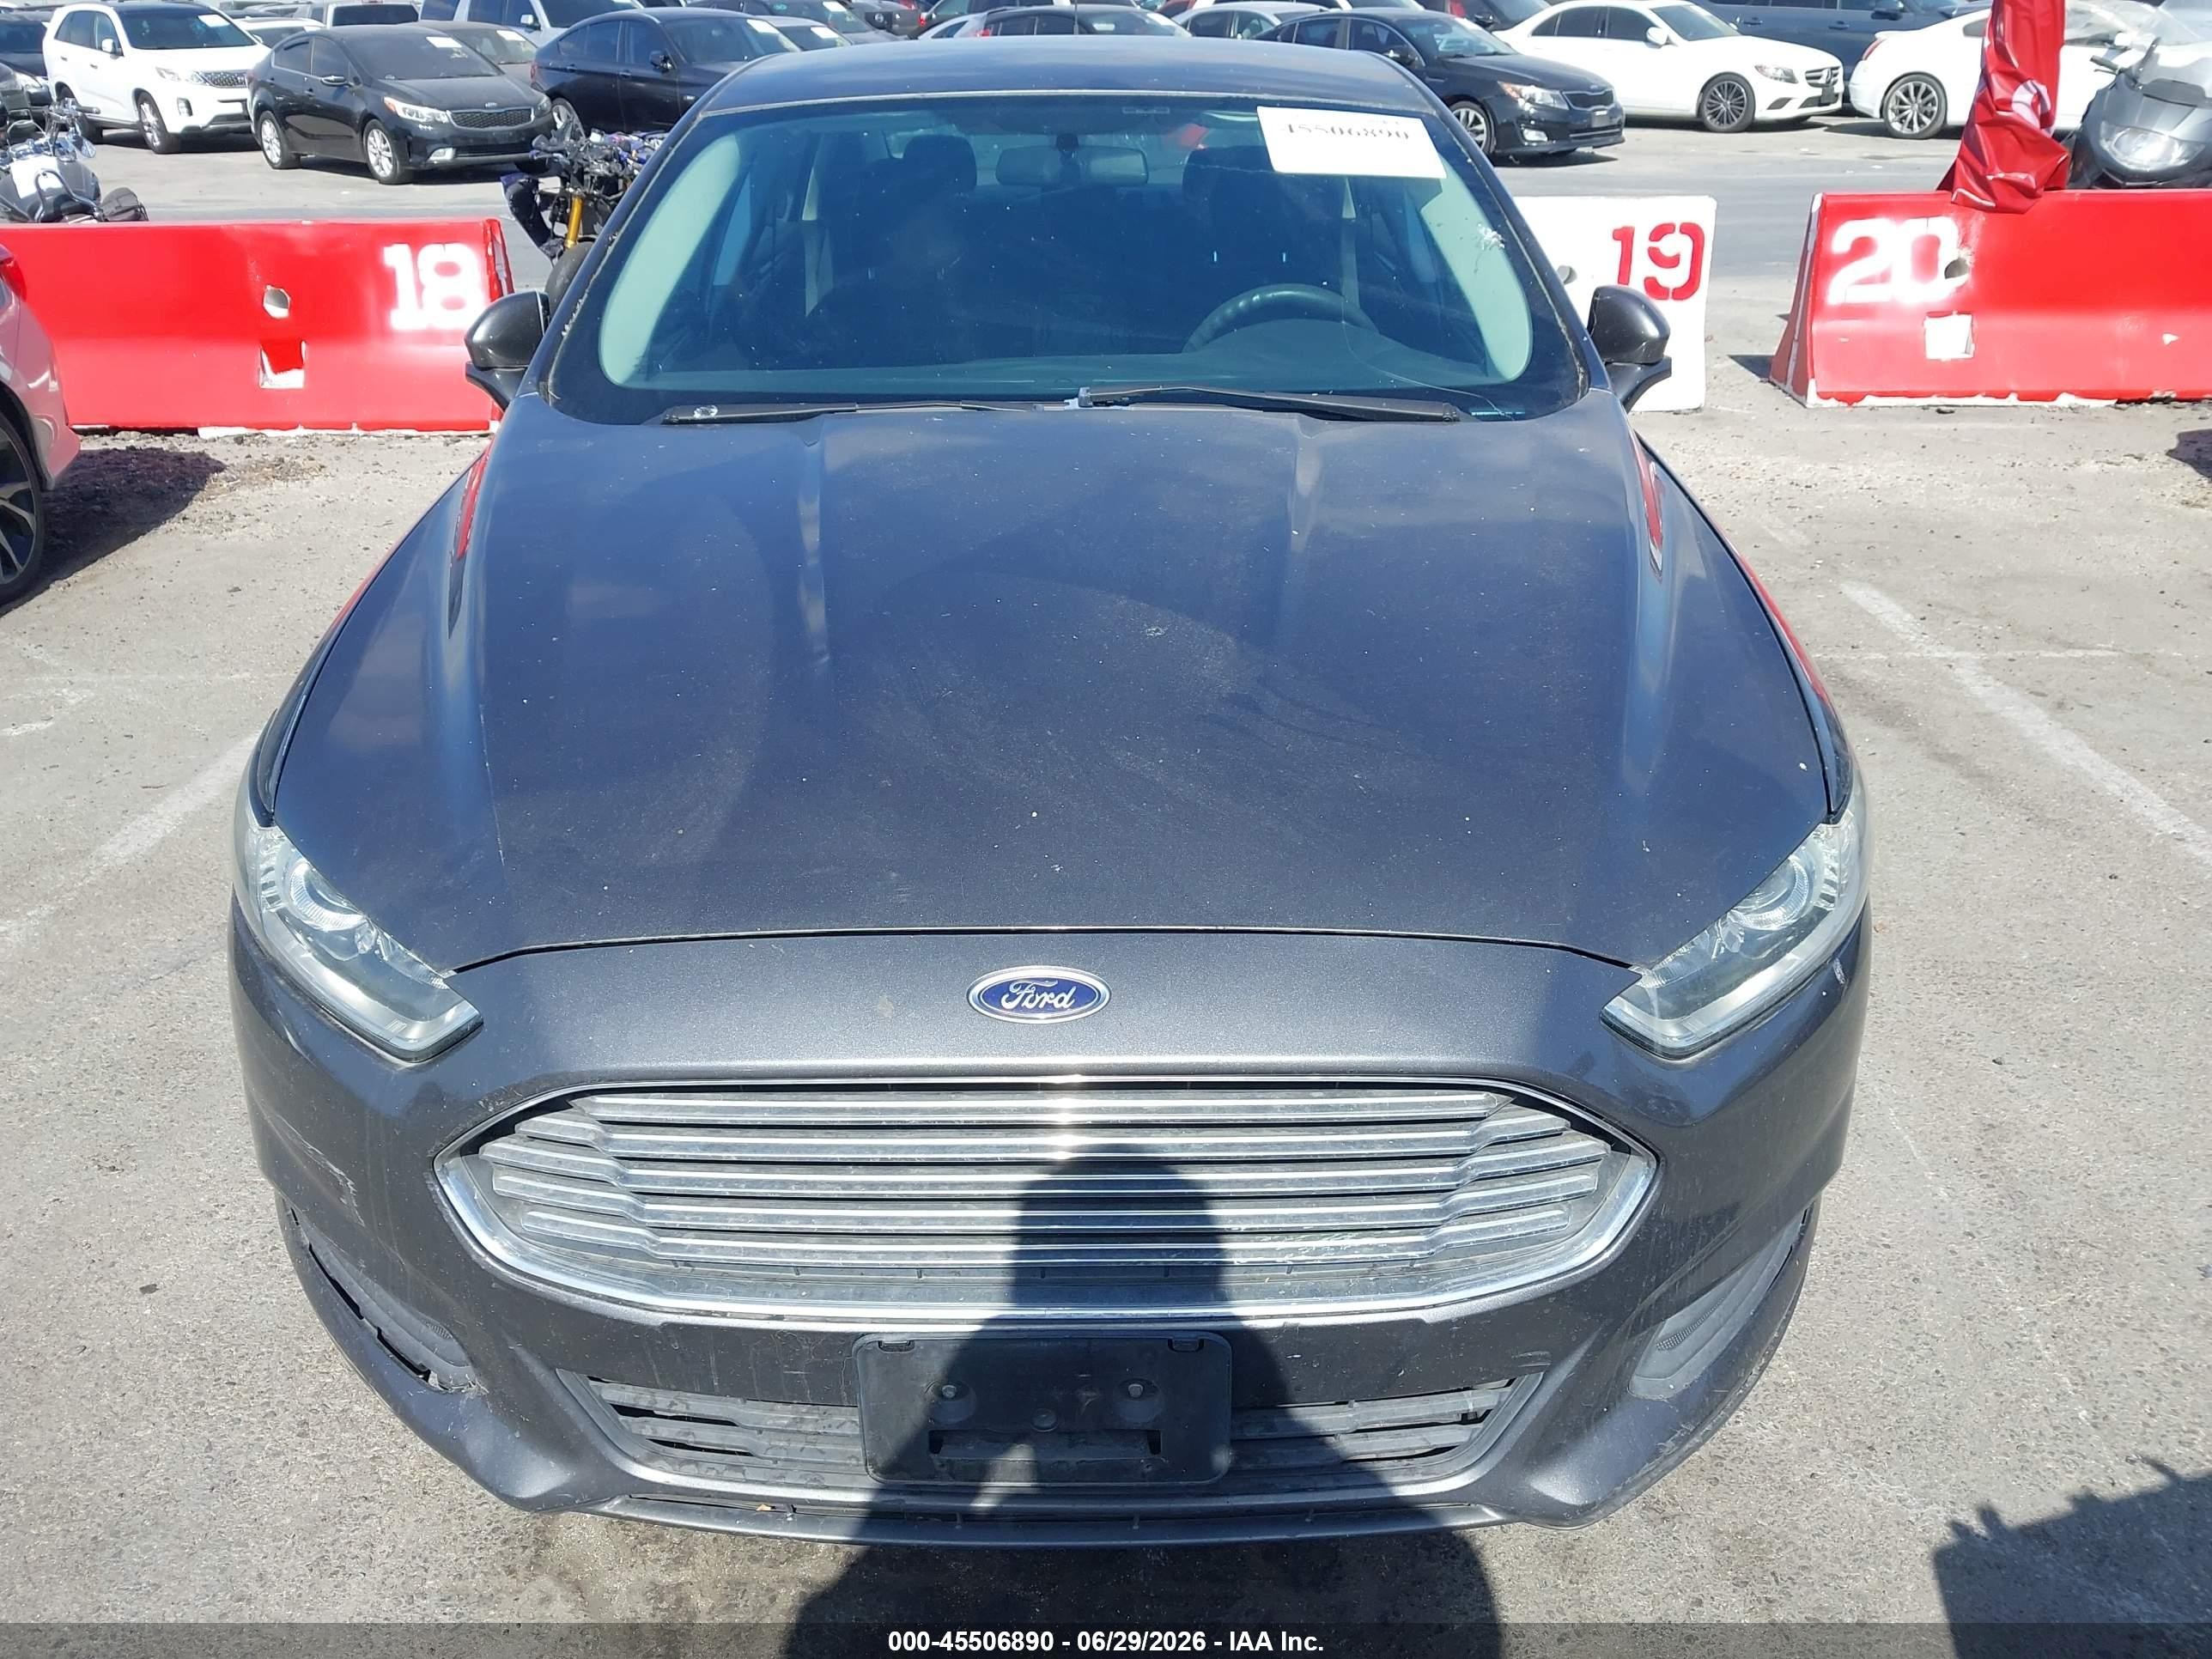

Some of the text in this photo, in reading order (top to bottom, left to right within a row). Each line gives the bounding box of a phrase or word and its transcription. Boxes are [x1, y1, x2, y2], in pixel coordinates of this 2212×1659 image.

[383, 242, 486, 331] 18
[1613, 222, 1705, 301] 19
[1826, 216, 1969, 306] 20
[1000, 980, 1077, 1010] Ford
